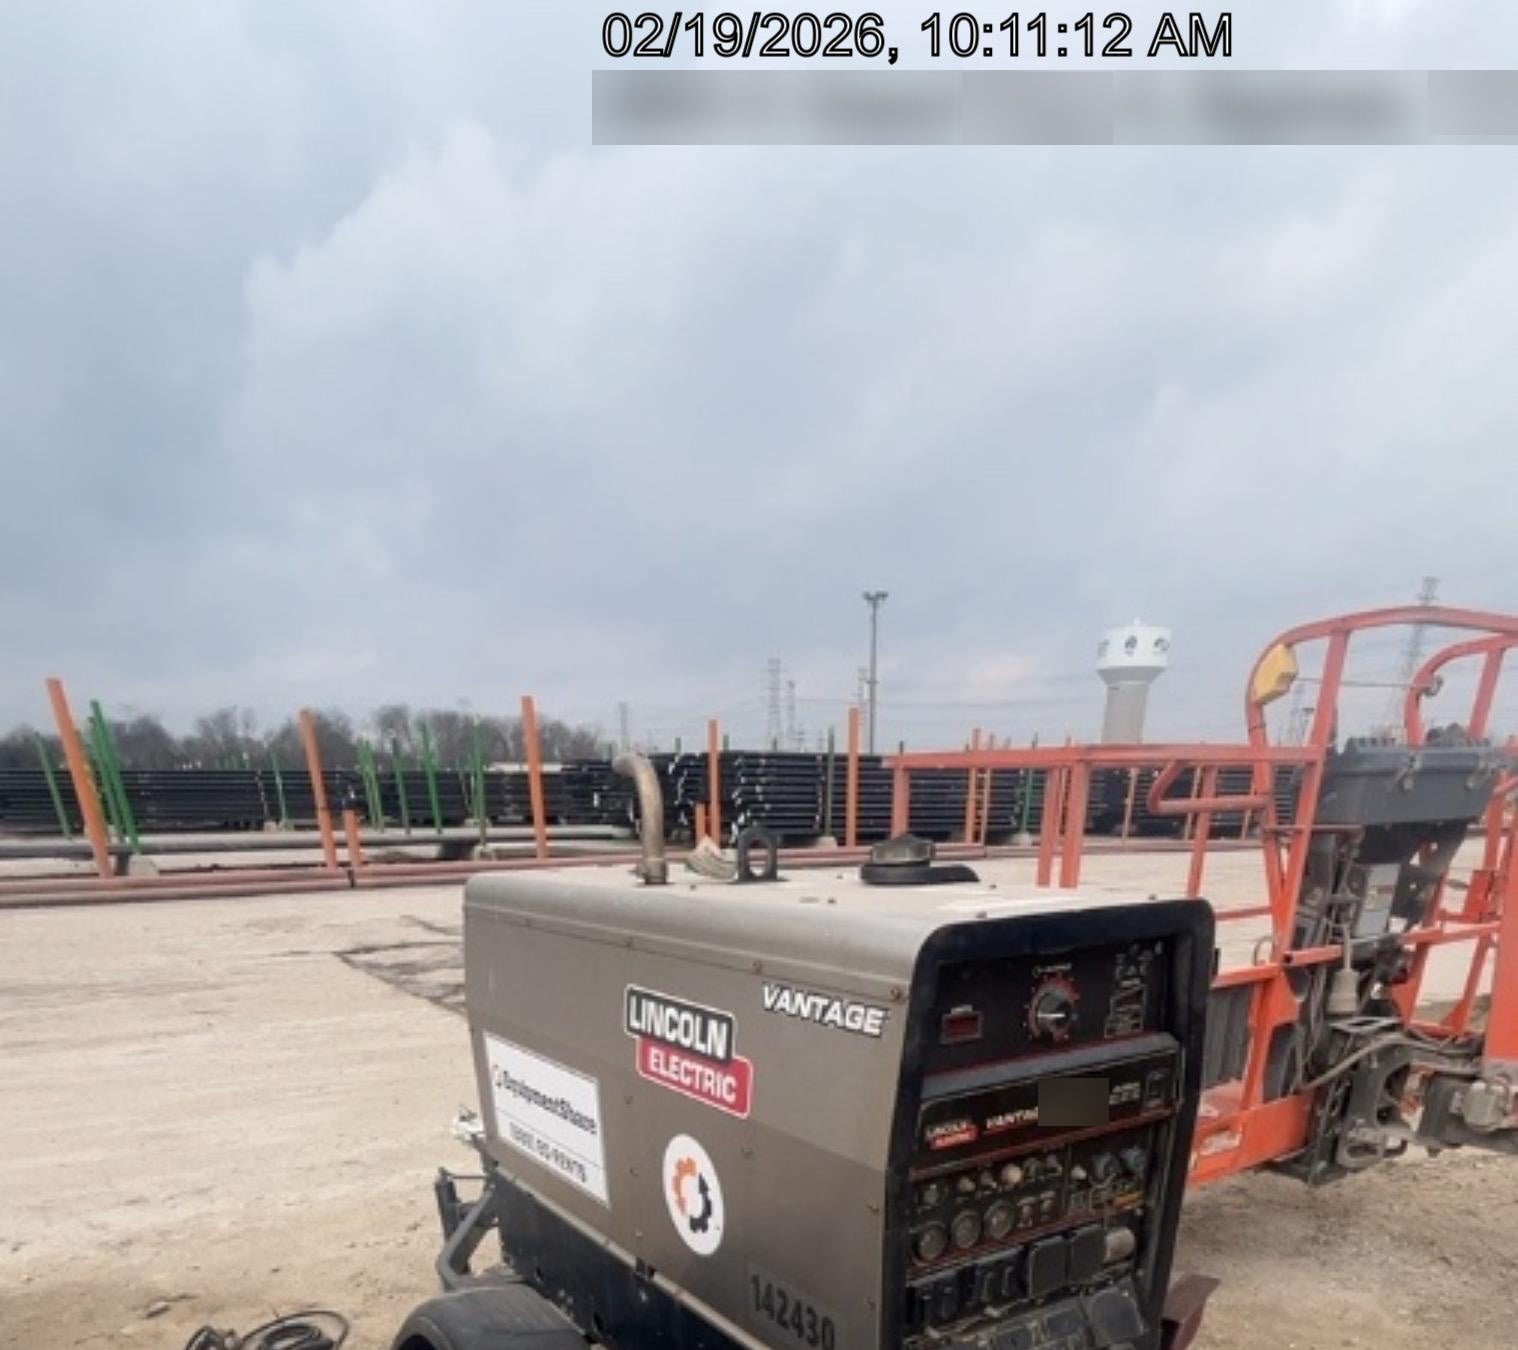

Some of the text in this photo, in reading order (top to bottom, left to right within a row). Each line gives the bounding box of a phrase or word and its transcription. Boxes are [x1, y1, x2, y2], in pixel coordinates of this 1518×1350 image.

[629, 994, 728, 1060] LINCOLN
[763, 982, 886, 1038] VANTAGE
[649, 1046, 737, 1105] ELECTRIC
